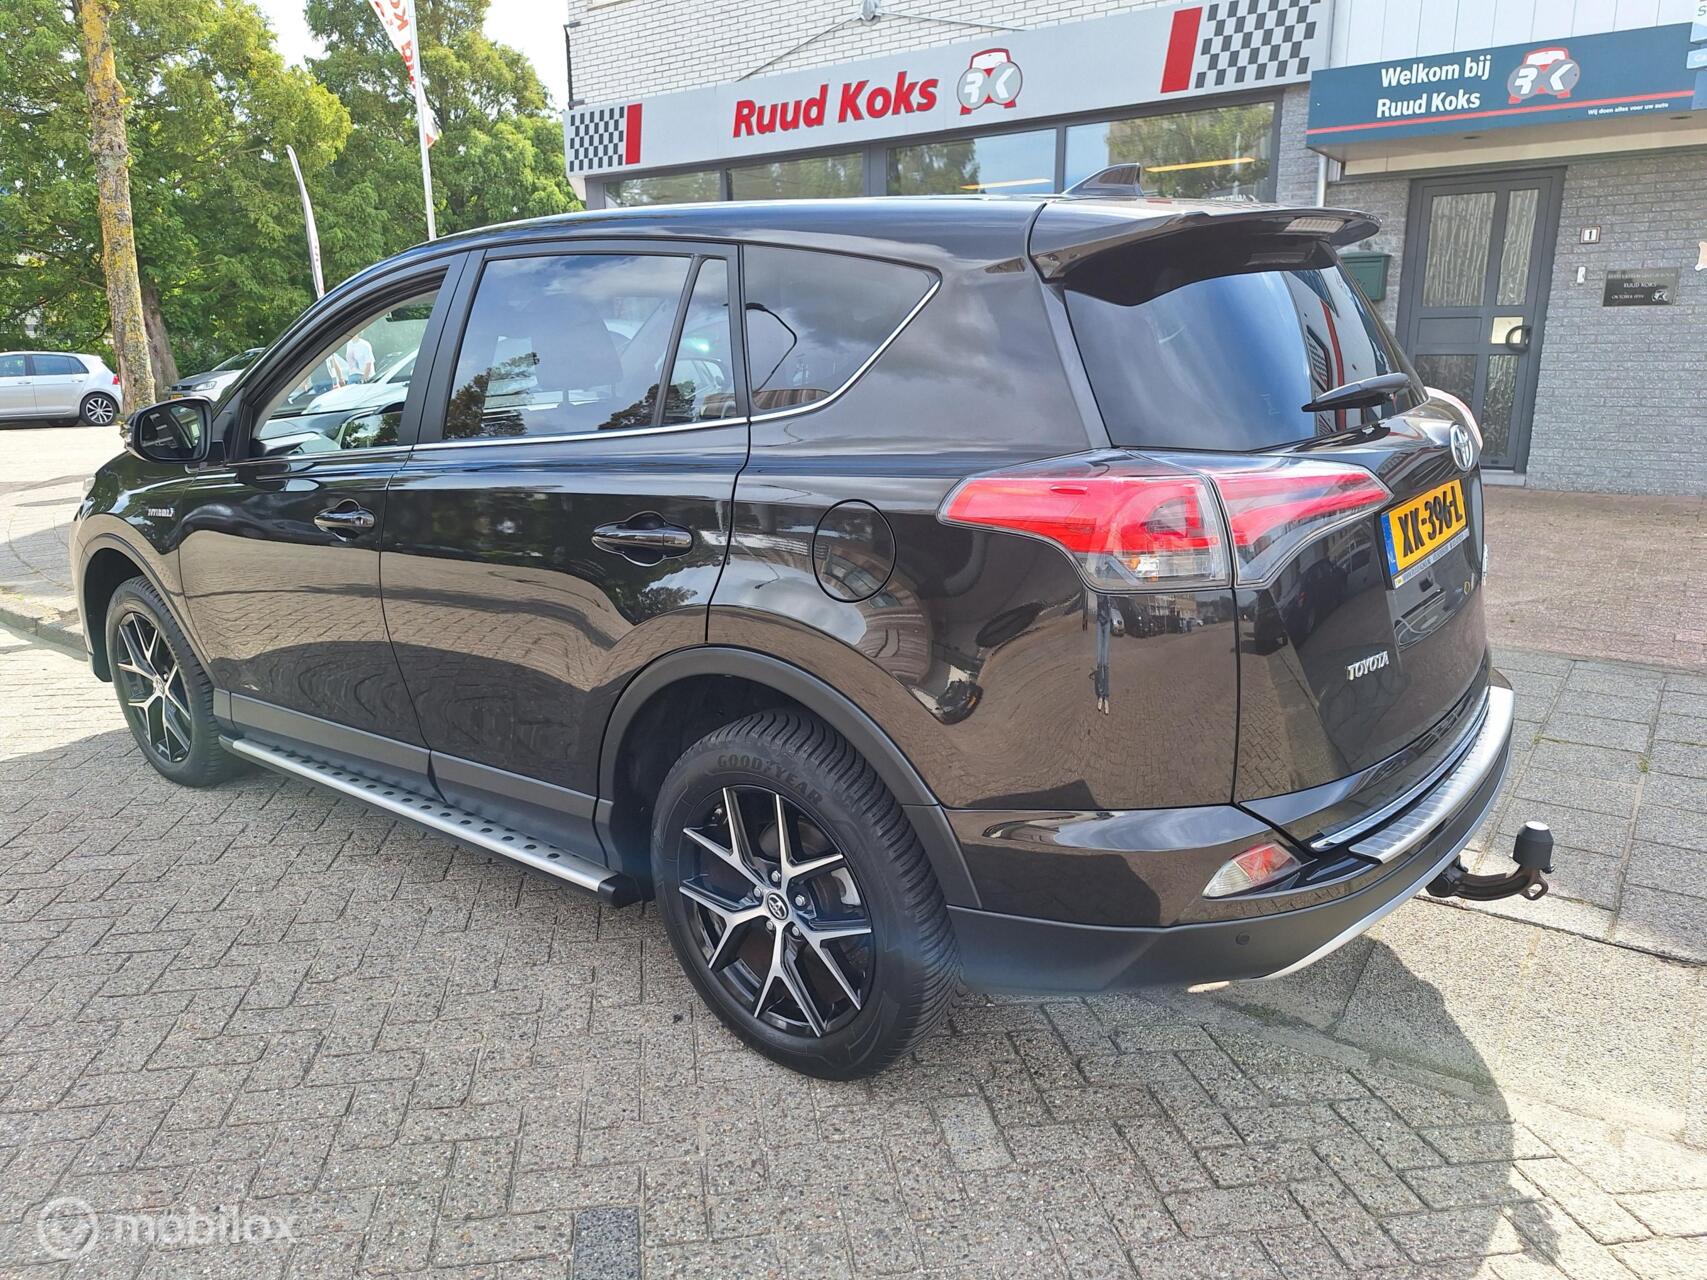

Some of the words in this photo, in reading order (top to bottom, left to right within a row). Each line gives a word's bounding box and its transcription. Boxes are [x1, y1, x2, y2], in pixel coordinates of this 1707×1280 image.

[1380, 63, 1459, 88] Welkom
[1464, 55, 1492, 80] bij
[732, 84, 829, 138] Ruud
[837, 70, 940, 123] Koks
[1376, 94, 1427, 119] Ruud
[1431, 88, 1481, 112] Koks
[1398, 486, 1463, 558] XK-396-L
[1346, 650, 1390, 681] TOYOTA
[717, 753, 823, 805] GOODYEAR
